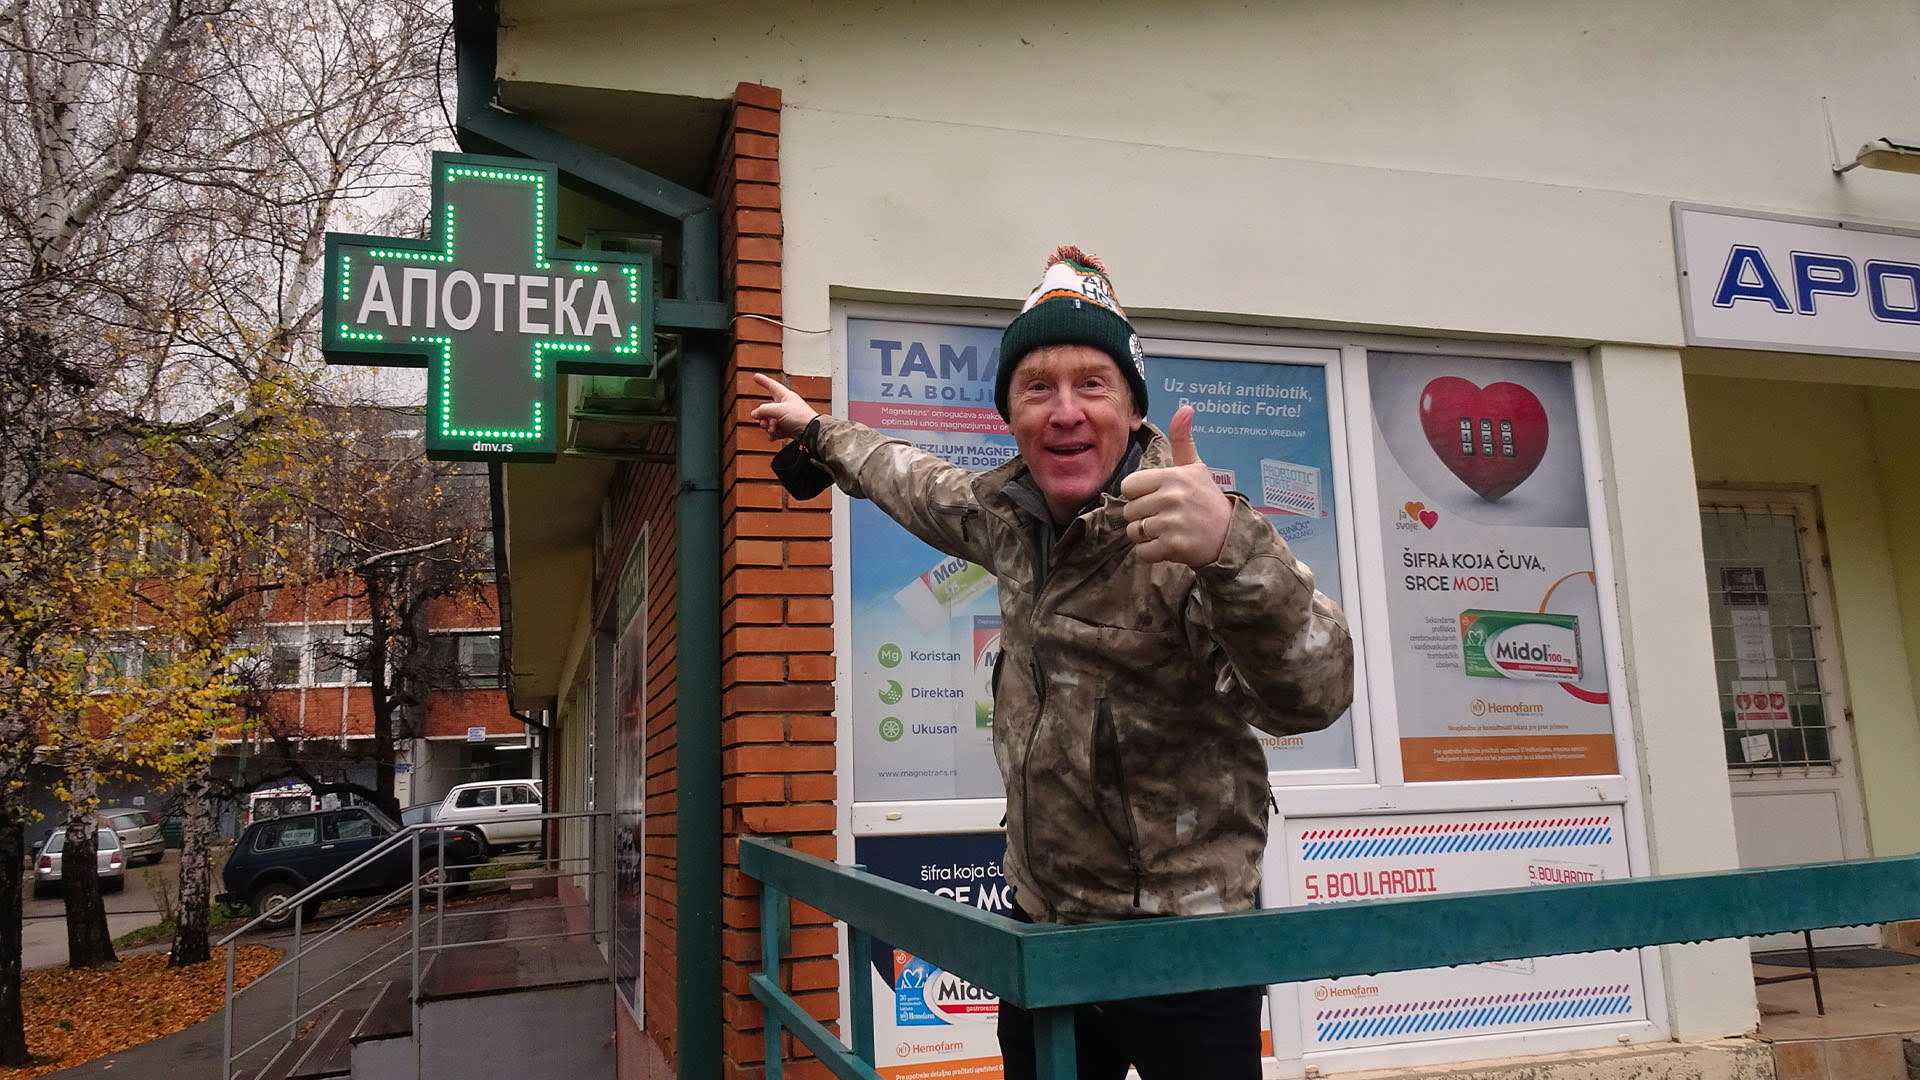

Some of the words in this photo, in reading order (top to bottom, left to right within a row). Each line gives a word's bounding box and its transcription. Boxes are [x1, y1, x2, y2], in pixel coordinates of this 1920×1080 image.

[1713, 244, 1920, 325] APO
[356, 265, 622, 338] АПОТЕКА
[881, 382, 912, 398] ZA
[1164, 378, 1184, 392] Uz
[1189, 381, 1232, 396] svaki
[1235, 384, 1312, 402] antibiotik,
[1255, 402, 1301, 418] Forte!
[1216, 426, 1268, 437] DVOSTRUKO
[473, 441, 513, 452] dmv.rs
[955, 456, 969, 466] JE
[1395, 519, 1418, 532] svoje
[1403, 547, 1450, 568] ŠIFRA
[1452, 553, 1494, 569] KOJA
[1497, 549, 1546, 572] ČUVA,
[1405, 575, 1450, 591] SRCE
[1453, 576, 1499, 591] MOJE!
[881, 650, 899, 663] Mg
[910, 650, 961, 661] Koristan
[1496, 641, 1548, 662] Midol
[1548, 653, 1562, 663] 100
[911, 687, 964, 698] Direktan
[1488, 701, 1544, 713] Hemofarm
[912, 724, 958, 735] Ukusan
[878, 768, 957, 778] www.magnetrans.rs
[920, 864, 951, 881] šifra
[953, 863, 985, 882] koja
[1528, 865, 1538, 880] S.
[1305, 874, 1324, 899] S.
[1326, 867, 1437, 898] BOULARDII
[1330, 985, 1379, 998] Hemofarm
[912, 1041, 964, 1054] Hemofarm
